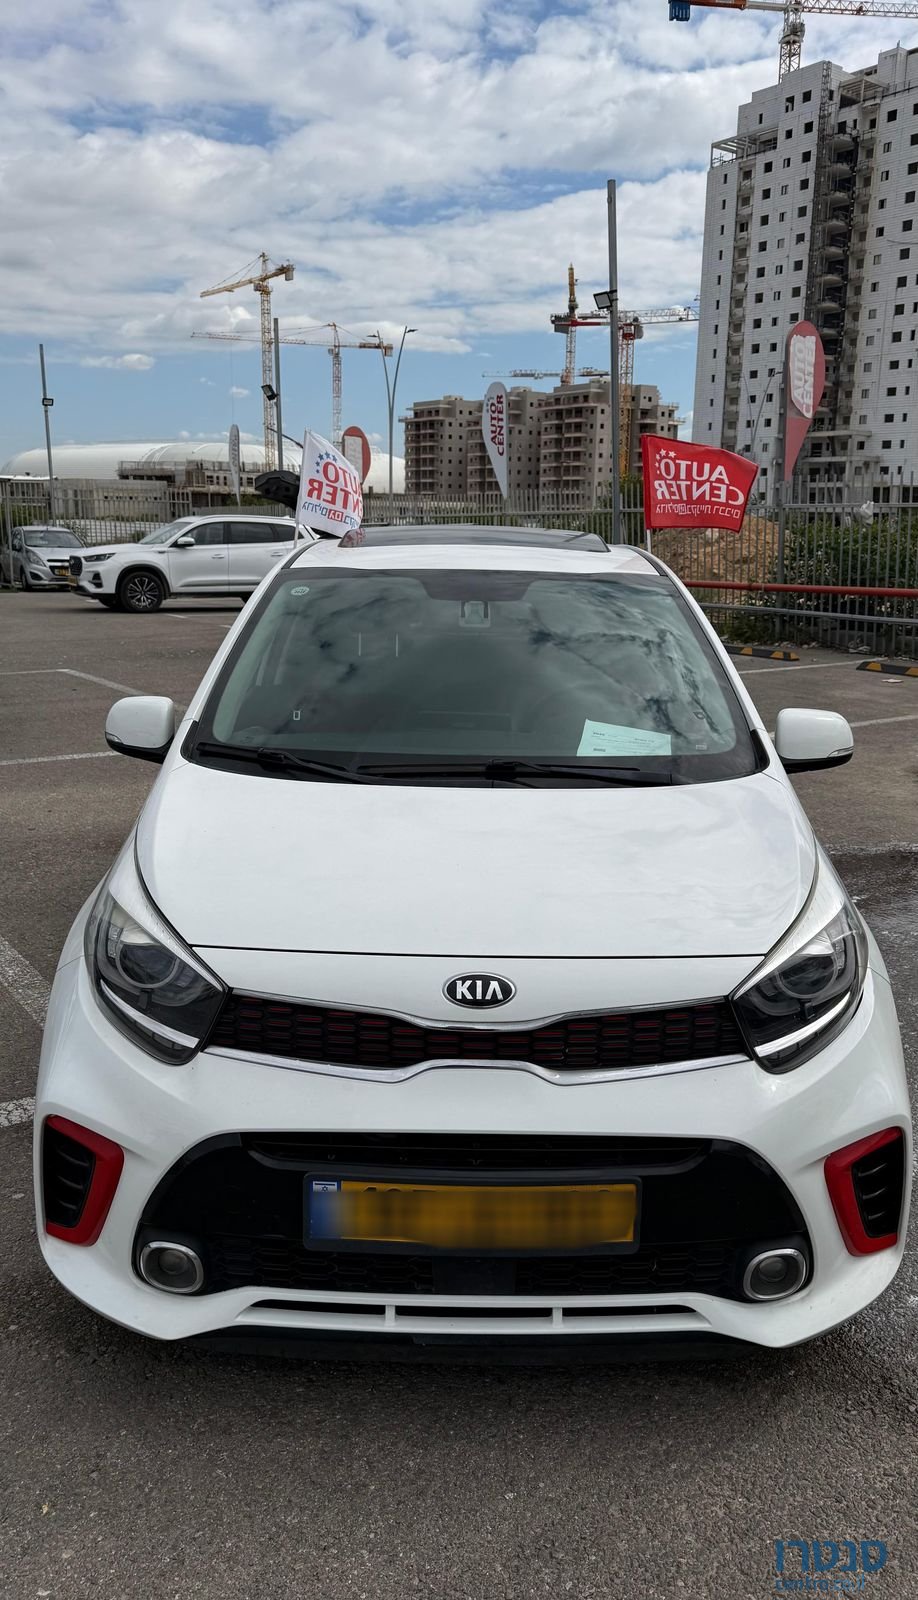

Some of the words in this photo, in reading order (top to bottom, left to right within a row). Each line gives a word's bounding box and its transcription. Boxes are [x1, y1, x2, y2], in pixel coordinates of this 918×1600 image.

[793, 342, 804, 404] AUTO
[490, 402, 498, 446] AUTO
[496, 394, 505, 457] CENTER
[456, 980, 503, 1000] KIA
